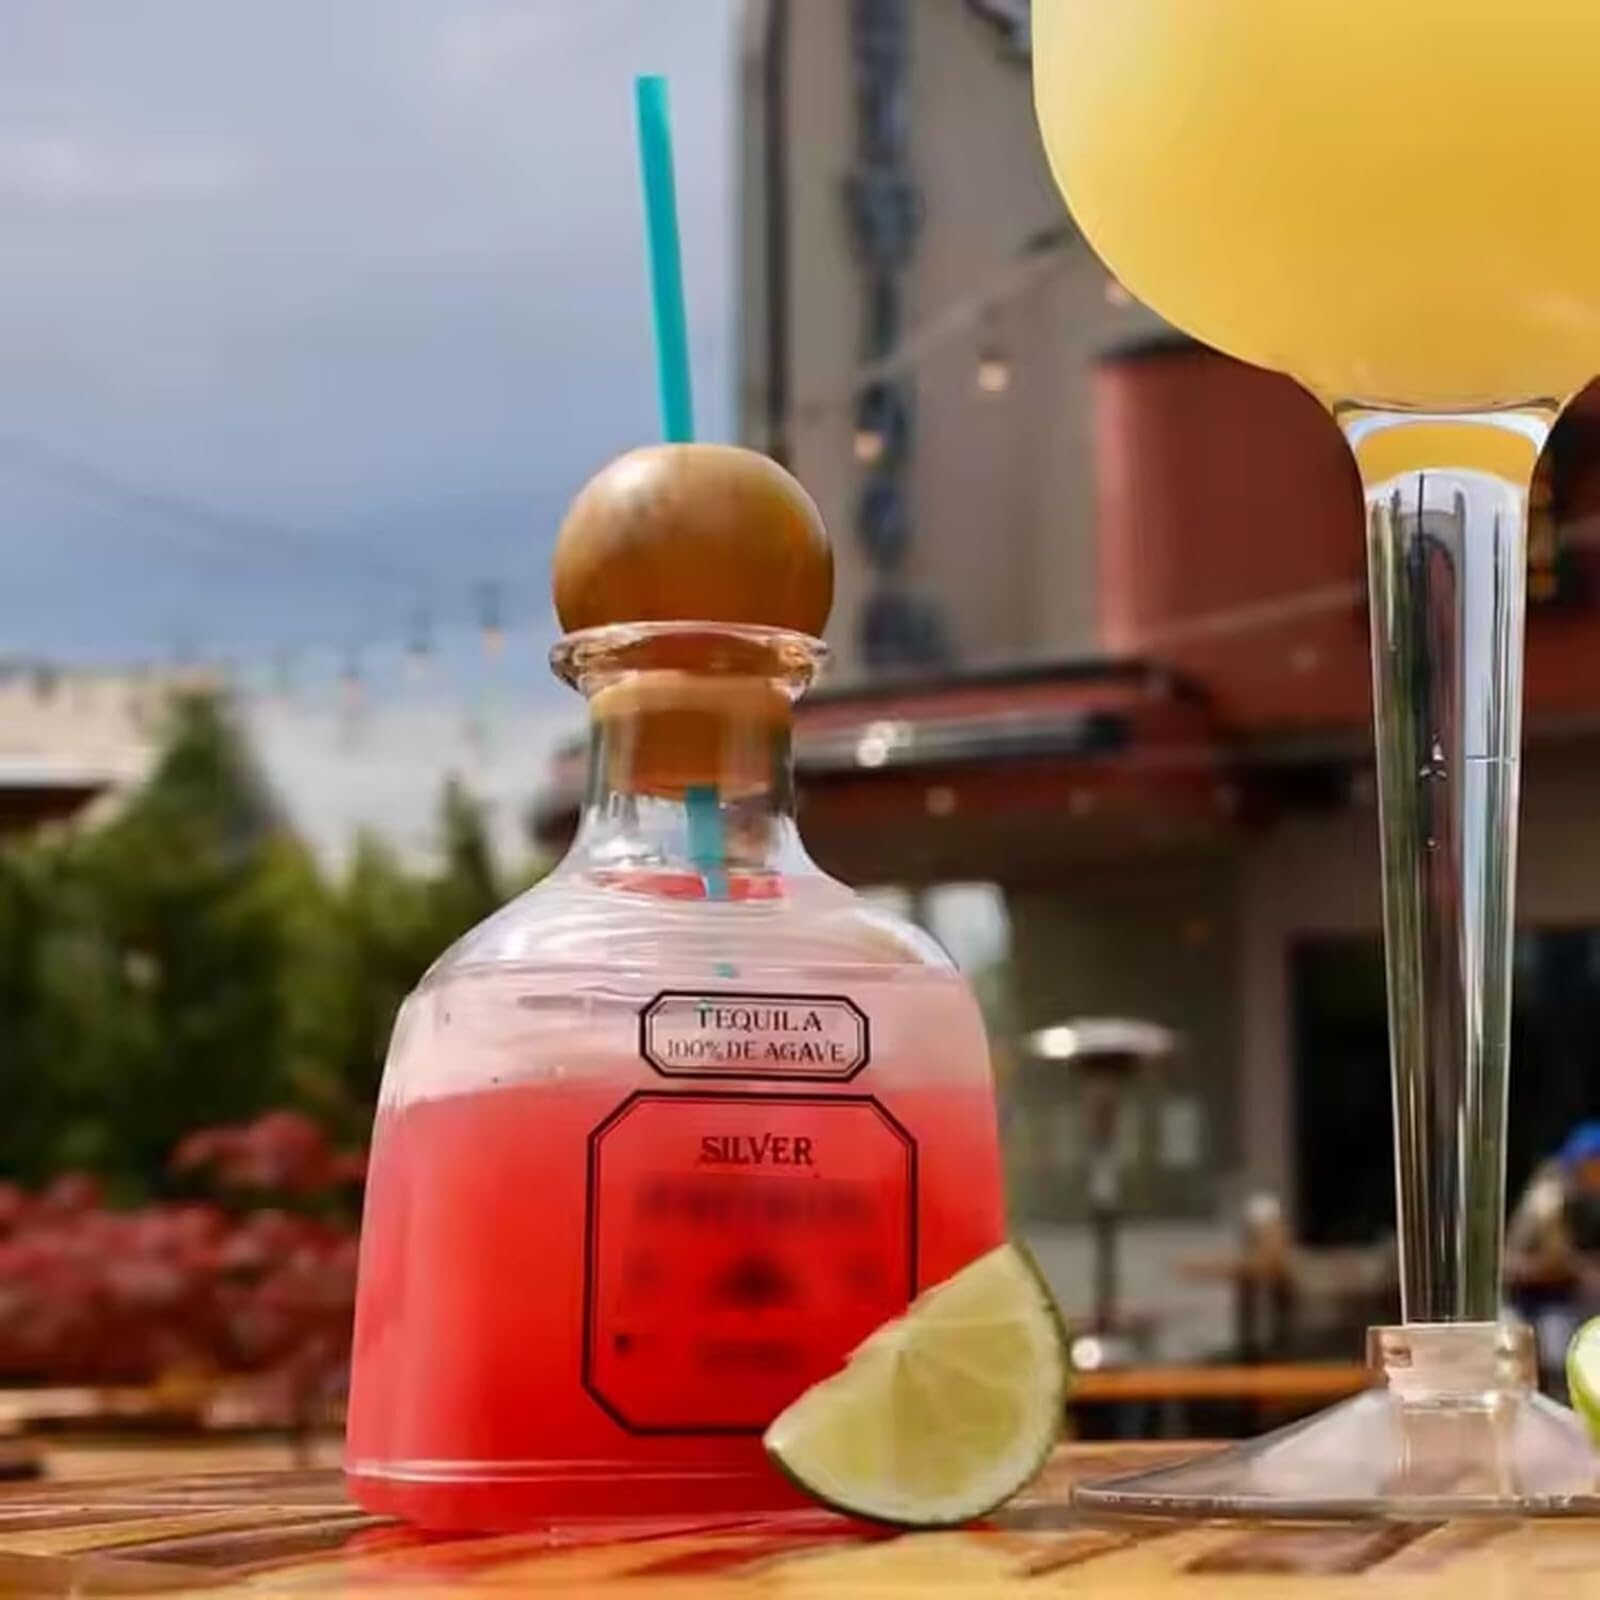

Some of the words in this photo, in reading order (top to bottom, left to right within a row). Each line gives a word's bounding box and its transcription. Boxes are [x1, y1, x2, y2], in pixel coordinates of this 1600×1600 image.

[695, 1007, 823, 1032] TEQUILA
[764, 1041, 846, 1064] AGAVE
[698, 1133, 815, 1166] SILVER
